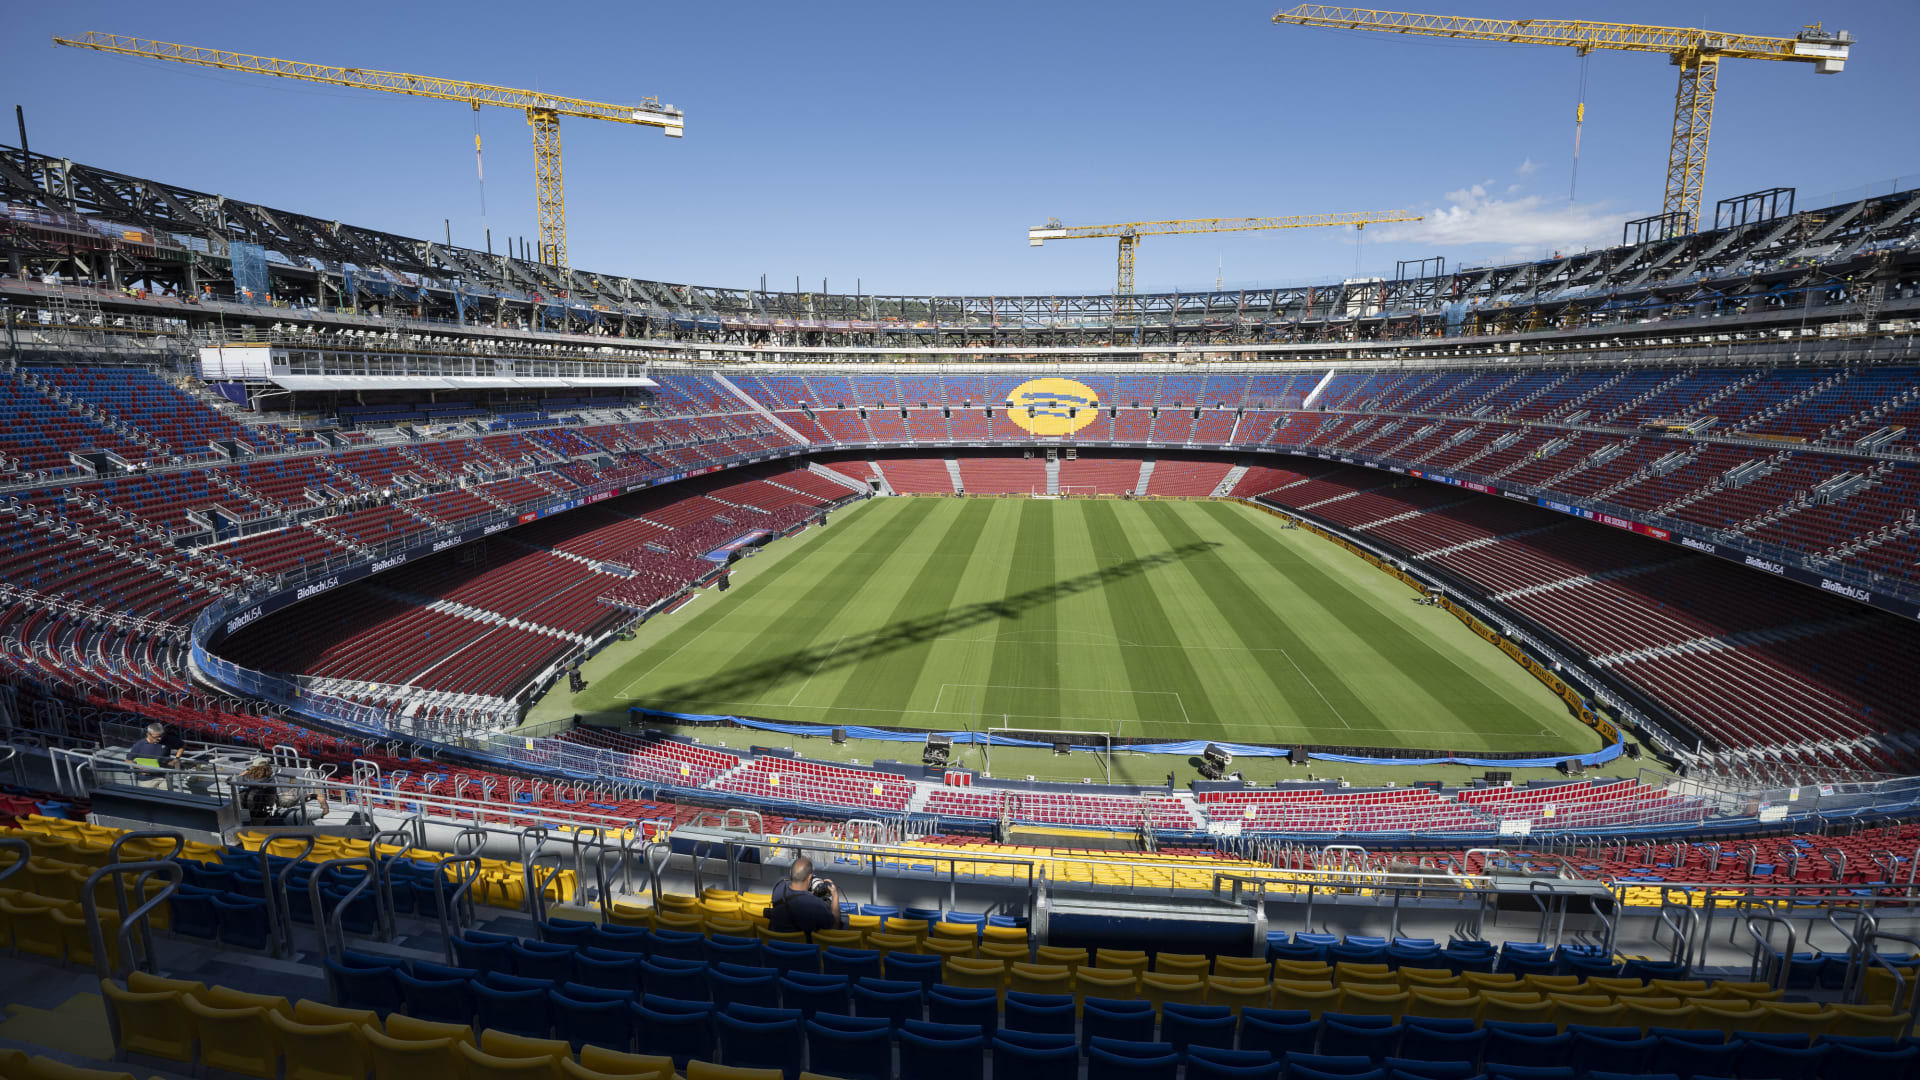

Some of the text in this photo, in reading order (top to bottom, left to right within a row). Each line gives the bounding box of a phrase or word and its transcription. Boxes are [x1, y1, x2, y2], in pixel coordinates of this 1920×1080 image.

[433, 536, 462, 552] BioTechUSA
[1682, 537, 1715, 554] BioTechUSA
[372, 554, 406, 572] BioTechUSA
[1745, 556, 1784, 575] BioTechUSA
[298, 576, 338, 600] BioTechUSA
[1821, 579, 1870, 602] BioTechUSA
[226, 606, 262, 634] BioTechUSA
[1502, 642, 1521, 660] STANLEY
[1532, 665, 1554, 684] STANLEY
